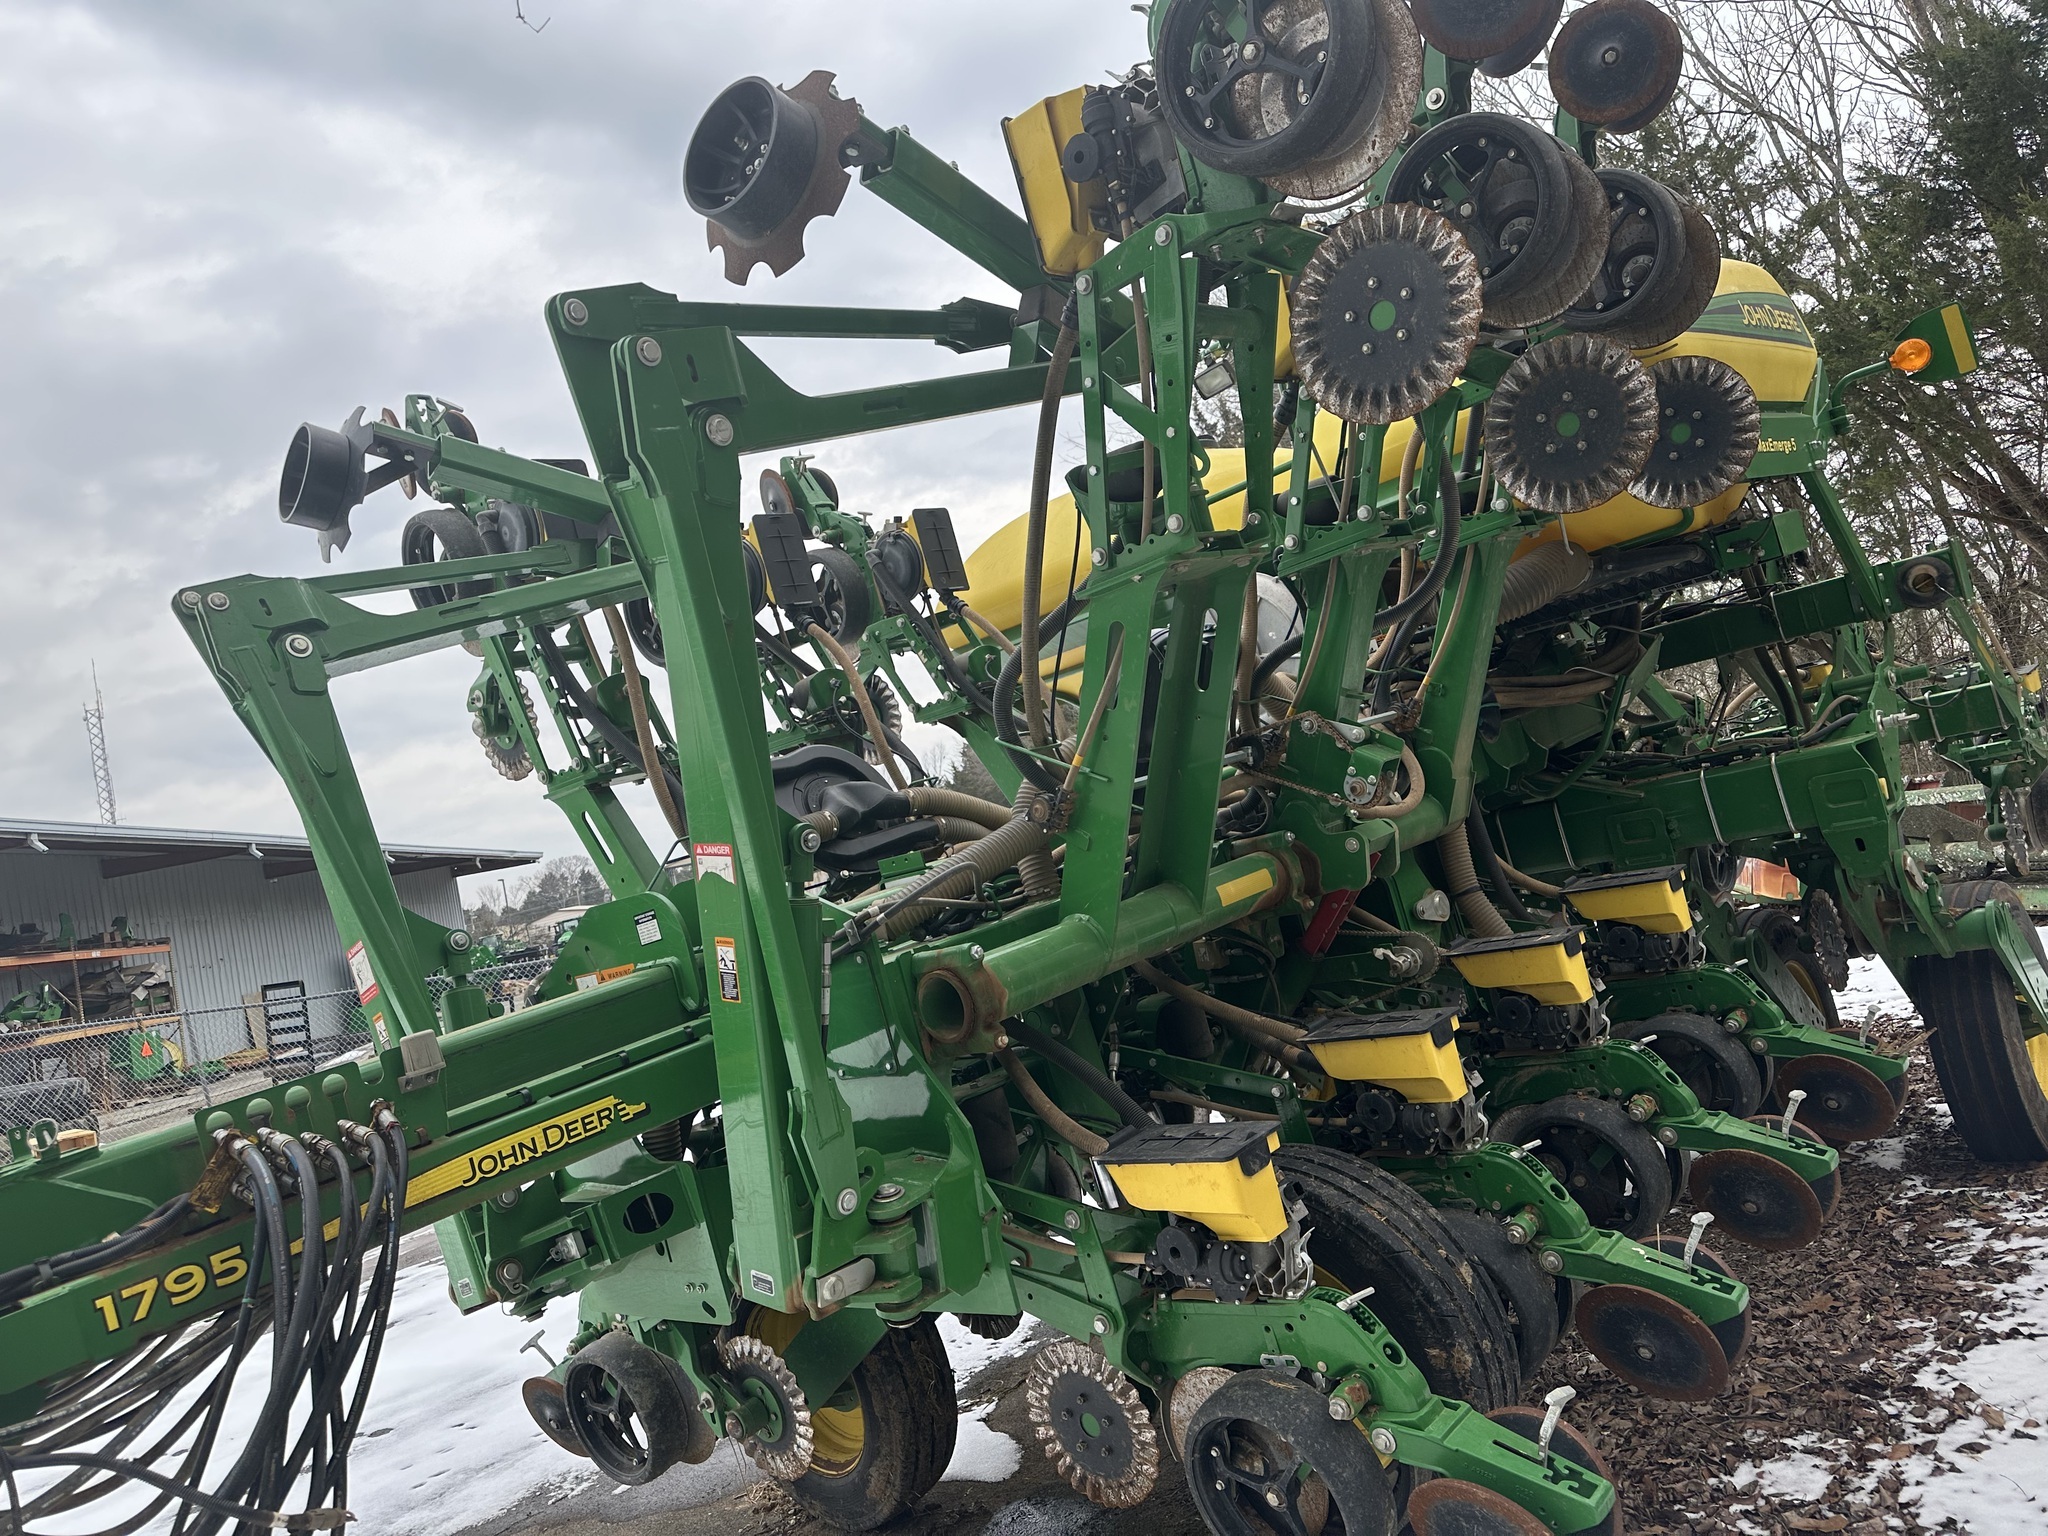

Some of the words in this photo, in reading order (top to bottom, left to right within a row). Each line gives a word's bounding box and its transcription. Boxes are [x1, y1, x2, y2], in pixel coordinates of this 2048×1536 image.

[1737, 299, 1772, 328] JOHN
[1763, 303, 1802, 333] DEERE
[703, 845, 730, 855] DANGER
[607, 968, 632, 980] WARNING
[462, 1136, 538, 1186] JOHN
[541, 1100, 632, 1152] DEERE
[94, 1245, 249, 1333] 1795
